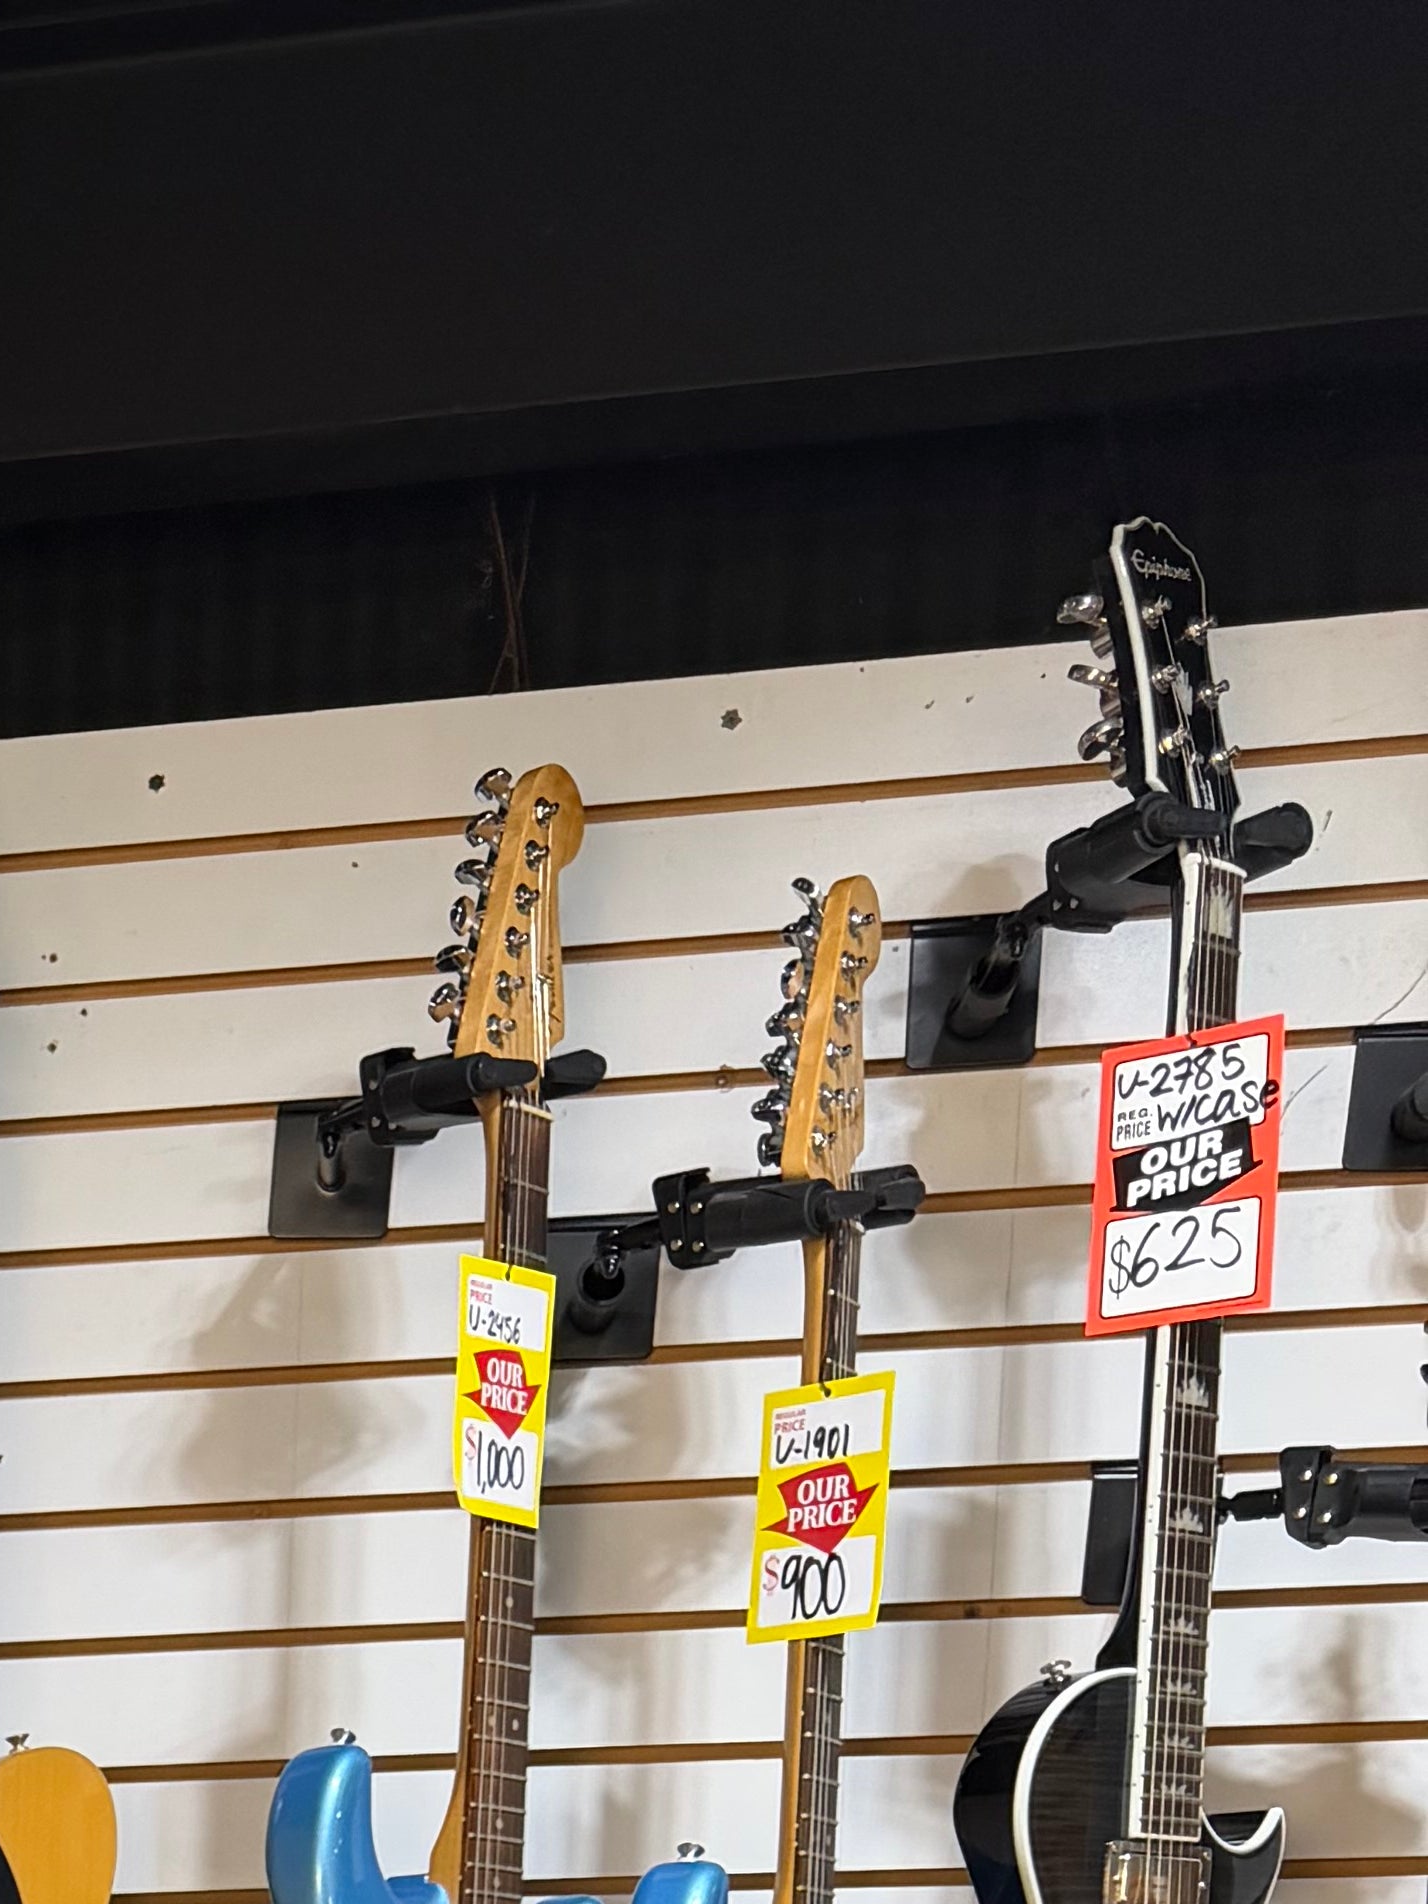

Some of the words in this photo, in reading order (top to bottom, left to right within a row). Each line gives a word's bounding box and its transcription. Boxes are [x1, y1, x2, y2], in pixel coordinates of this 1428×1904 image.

[1130, 549, 1192, 581] Epiphone
[1116, 1120, 1151, 1142] PRICE
[1140, 1129, 1224, 1175] OUR
[1126, 1149, 1243, 1208] PRICE
[1109, 1206, 1242, 1300] $625
[486, 1357, 524, 1388] OUR
[480, 1383, 529, 1416] PRICE
[774, 1420, 806, 1436] PRICE
[465, 1424, 525, 1495] $1,000
[797, 1473, 850, 1505] OUR
[786, 1498, 858, 1533] PRICE
[763, 1552, 846, 1621] $900
